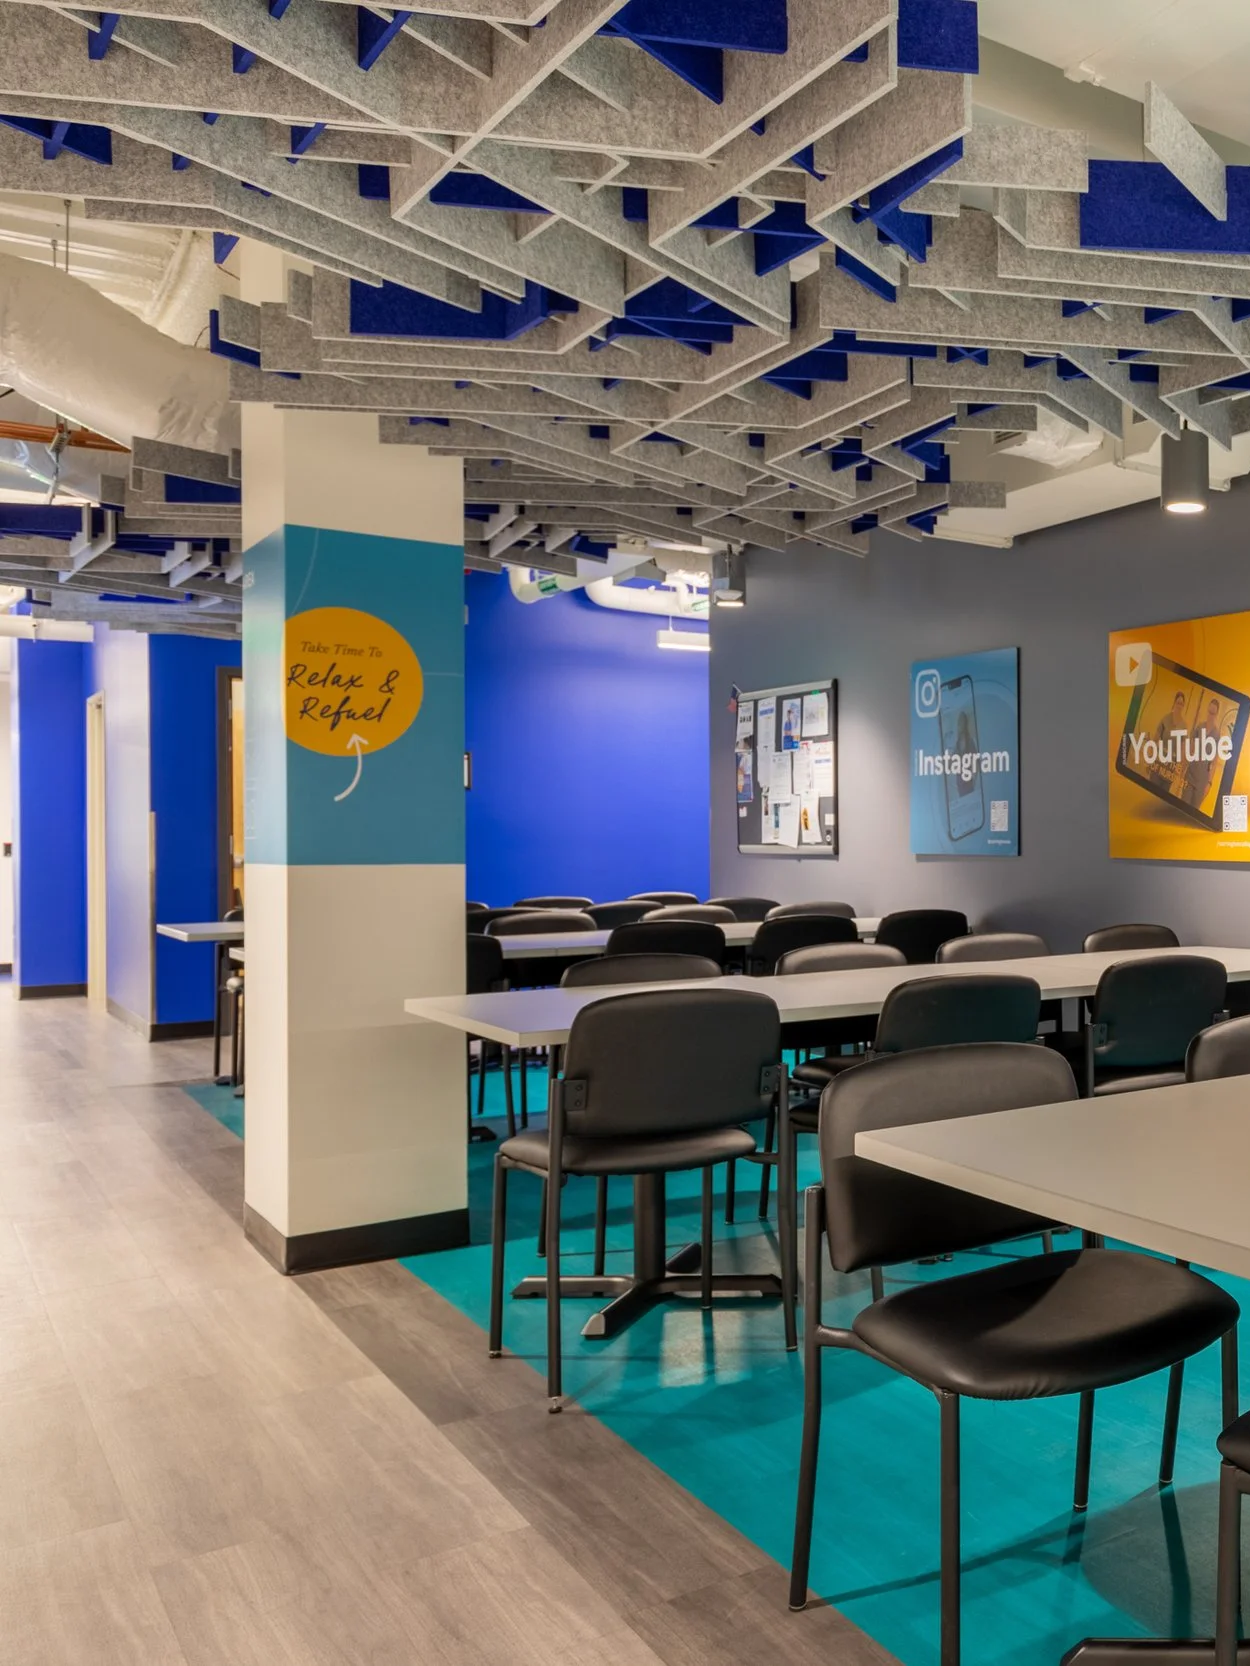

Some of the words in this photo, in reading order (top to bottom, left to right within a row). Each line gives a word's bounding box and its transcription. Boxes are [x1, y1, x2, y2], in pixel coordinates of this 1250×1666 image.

[301, 641, 330, 654] Take
[334, 644, 365, 657] Time
[369, 646, 383, 658] To
[287, 662, 364, 692] Relax
[378, 670, 399, 694] &
[299, 695, 391, 732] Refuel
[1128, 728, 1233, 764] YouTube
[919, 749, 1010, 782] Instagram
